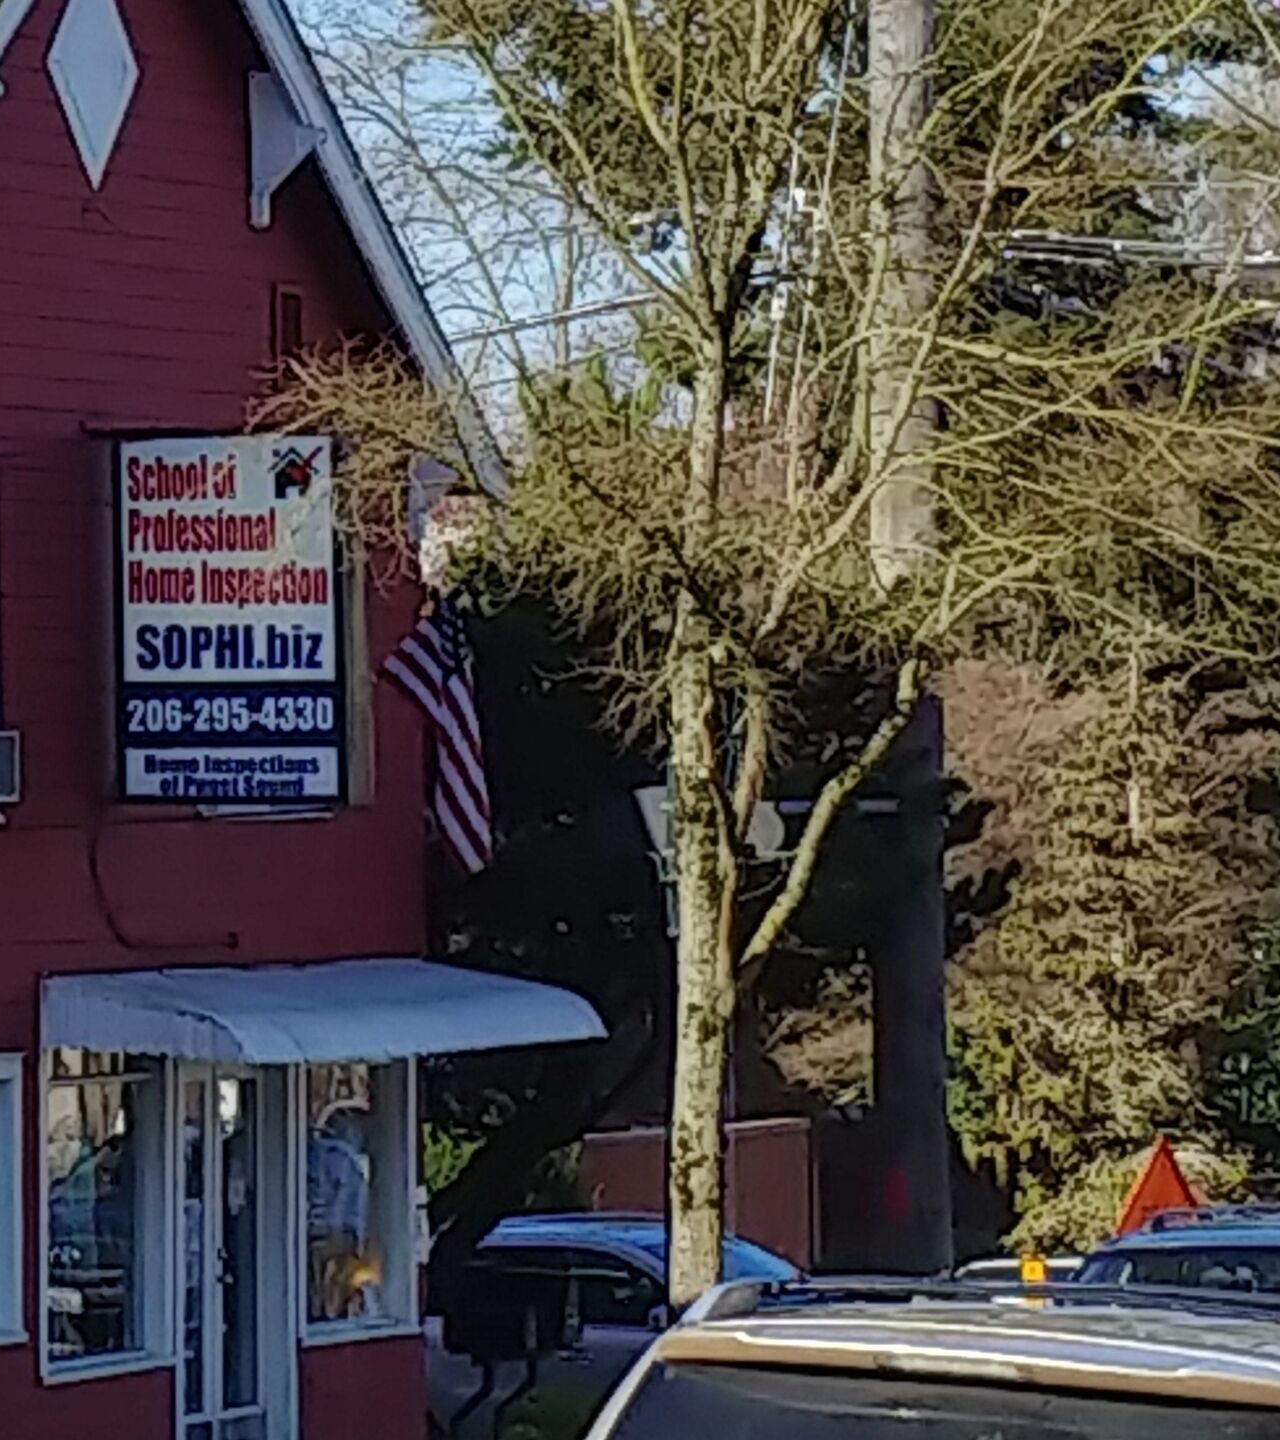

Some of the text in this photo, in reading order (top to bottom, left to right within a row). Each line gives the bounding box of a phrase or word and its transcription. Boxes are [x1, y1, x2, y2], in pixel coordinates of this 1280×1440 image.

[127, 453, 236, 501] School of
[128, 507, 276, 553] Professional
[128, 560, 328, 609] Home Inspection
[136, 624, 323, 670] SOPHI.biz
[126, 697, 334, 732] 206-295-4330
[203, 754, 321, 775] Inspections
